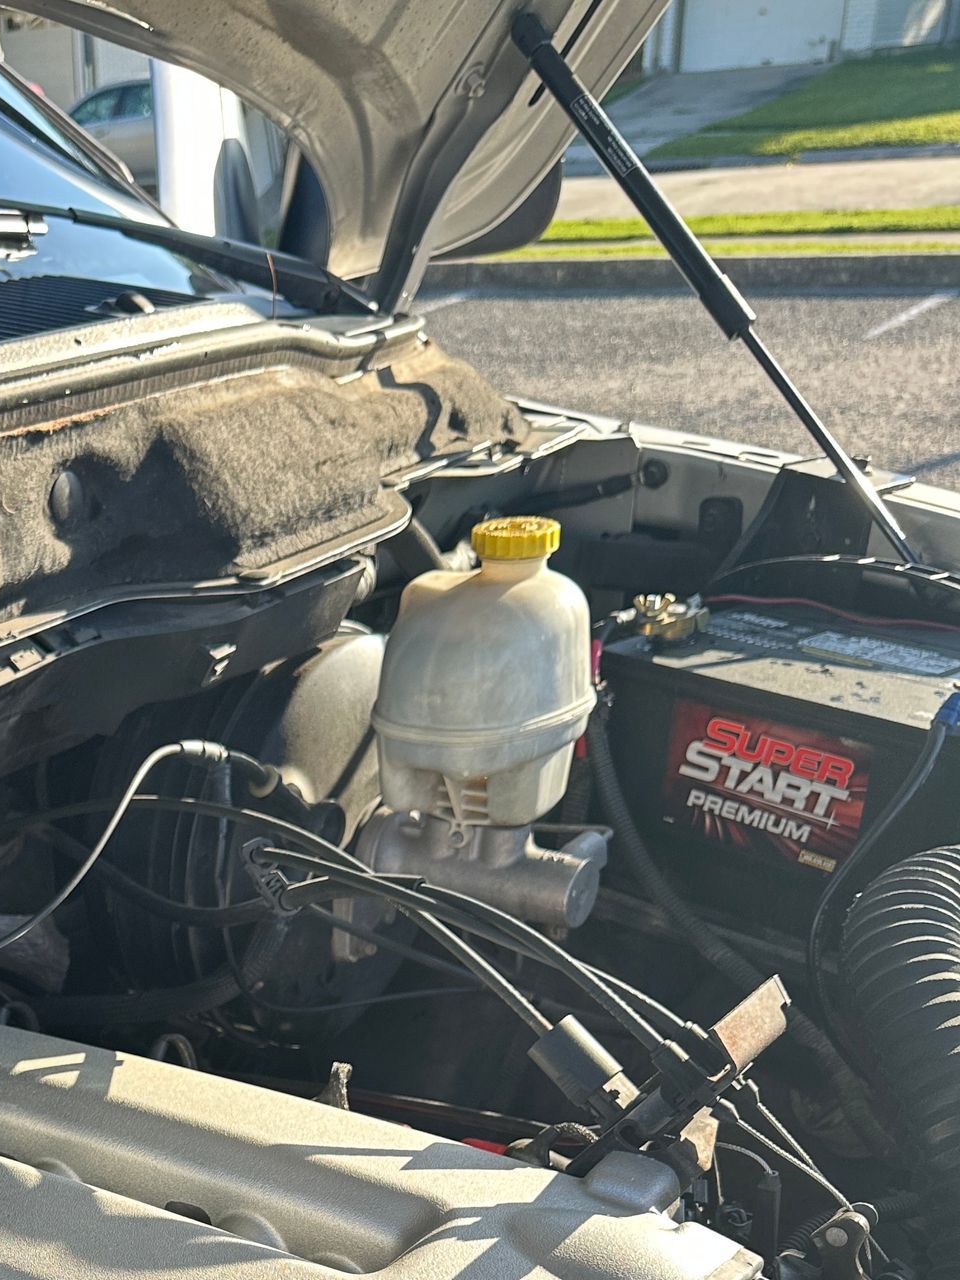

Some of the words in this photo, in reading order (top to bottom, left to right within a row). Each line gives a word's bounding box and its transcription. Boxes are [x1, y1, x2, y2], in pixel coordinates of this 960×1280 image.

[679, 740, 851, 818] START
[703, 716, 855, 788] SUPER
[686, 789, 813, 844] PREMIUM
